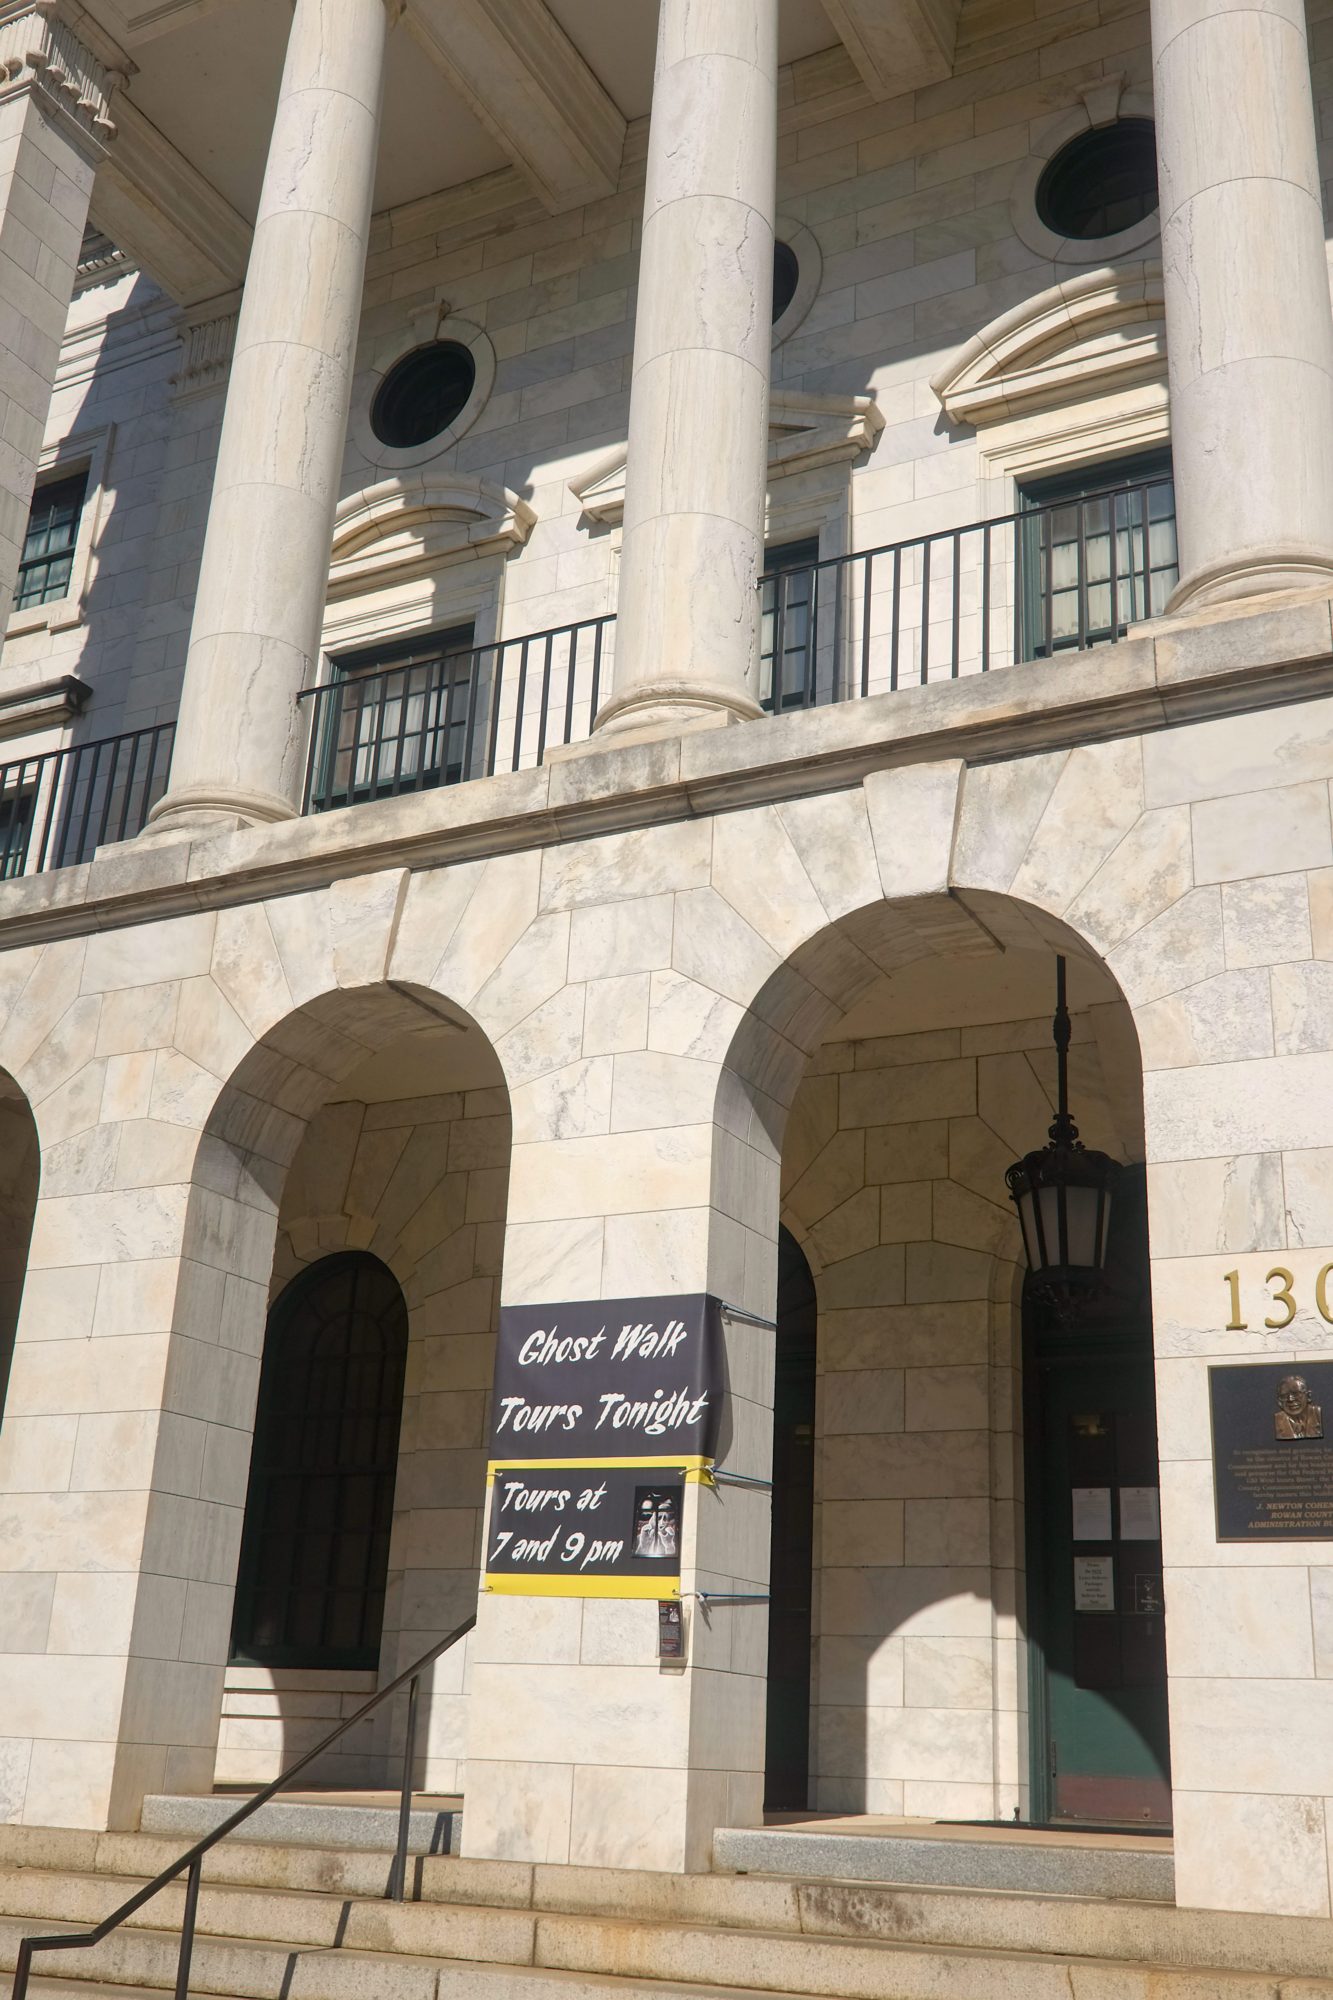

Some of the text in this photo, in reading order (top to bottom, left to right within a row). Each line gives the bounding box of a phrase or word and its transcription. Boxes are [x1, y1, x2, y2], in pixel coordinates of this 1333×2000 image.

[518, 1320, 688, 1367] Ghost Walk
[496, 1386, 710, 1436] Tours Tonight
[500, 1481, 608, 1512] Tours at
[1266, 1502, 1303, 1510] NEWTON
[1248, 1520, 1321, 1529] ADMINISTRATION
[489, 1525, 624, 1571] 7 and 9 pm
